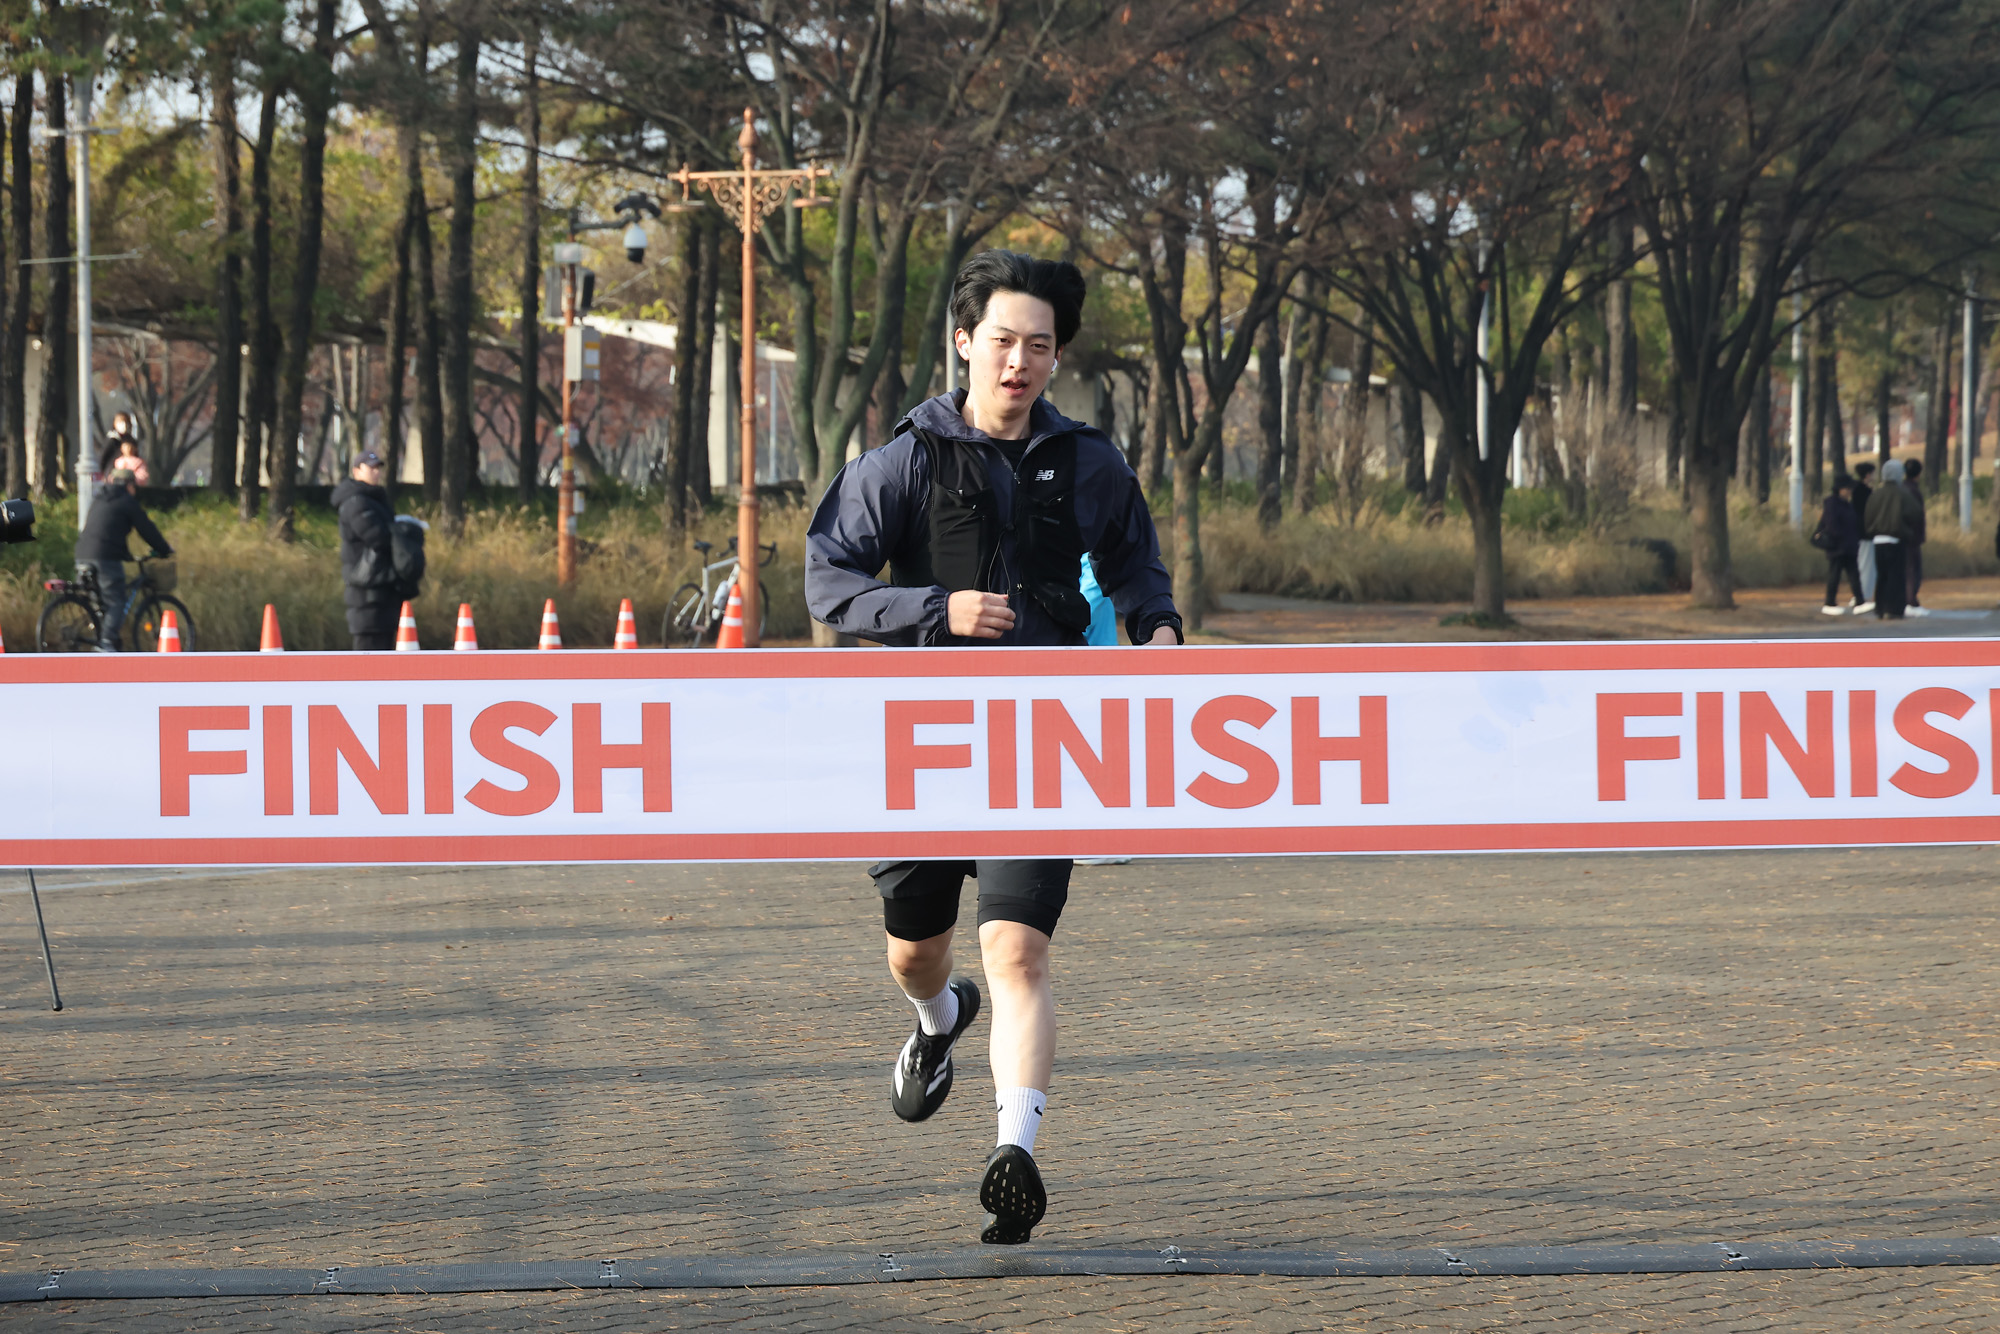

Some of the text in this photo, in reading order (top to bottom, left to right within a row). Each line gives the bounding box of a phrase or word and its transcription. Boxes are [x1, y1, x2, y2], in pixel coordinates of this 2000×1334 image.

[159, 687, 2000, 817] FINISH FINISH FINIS
